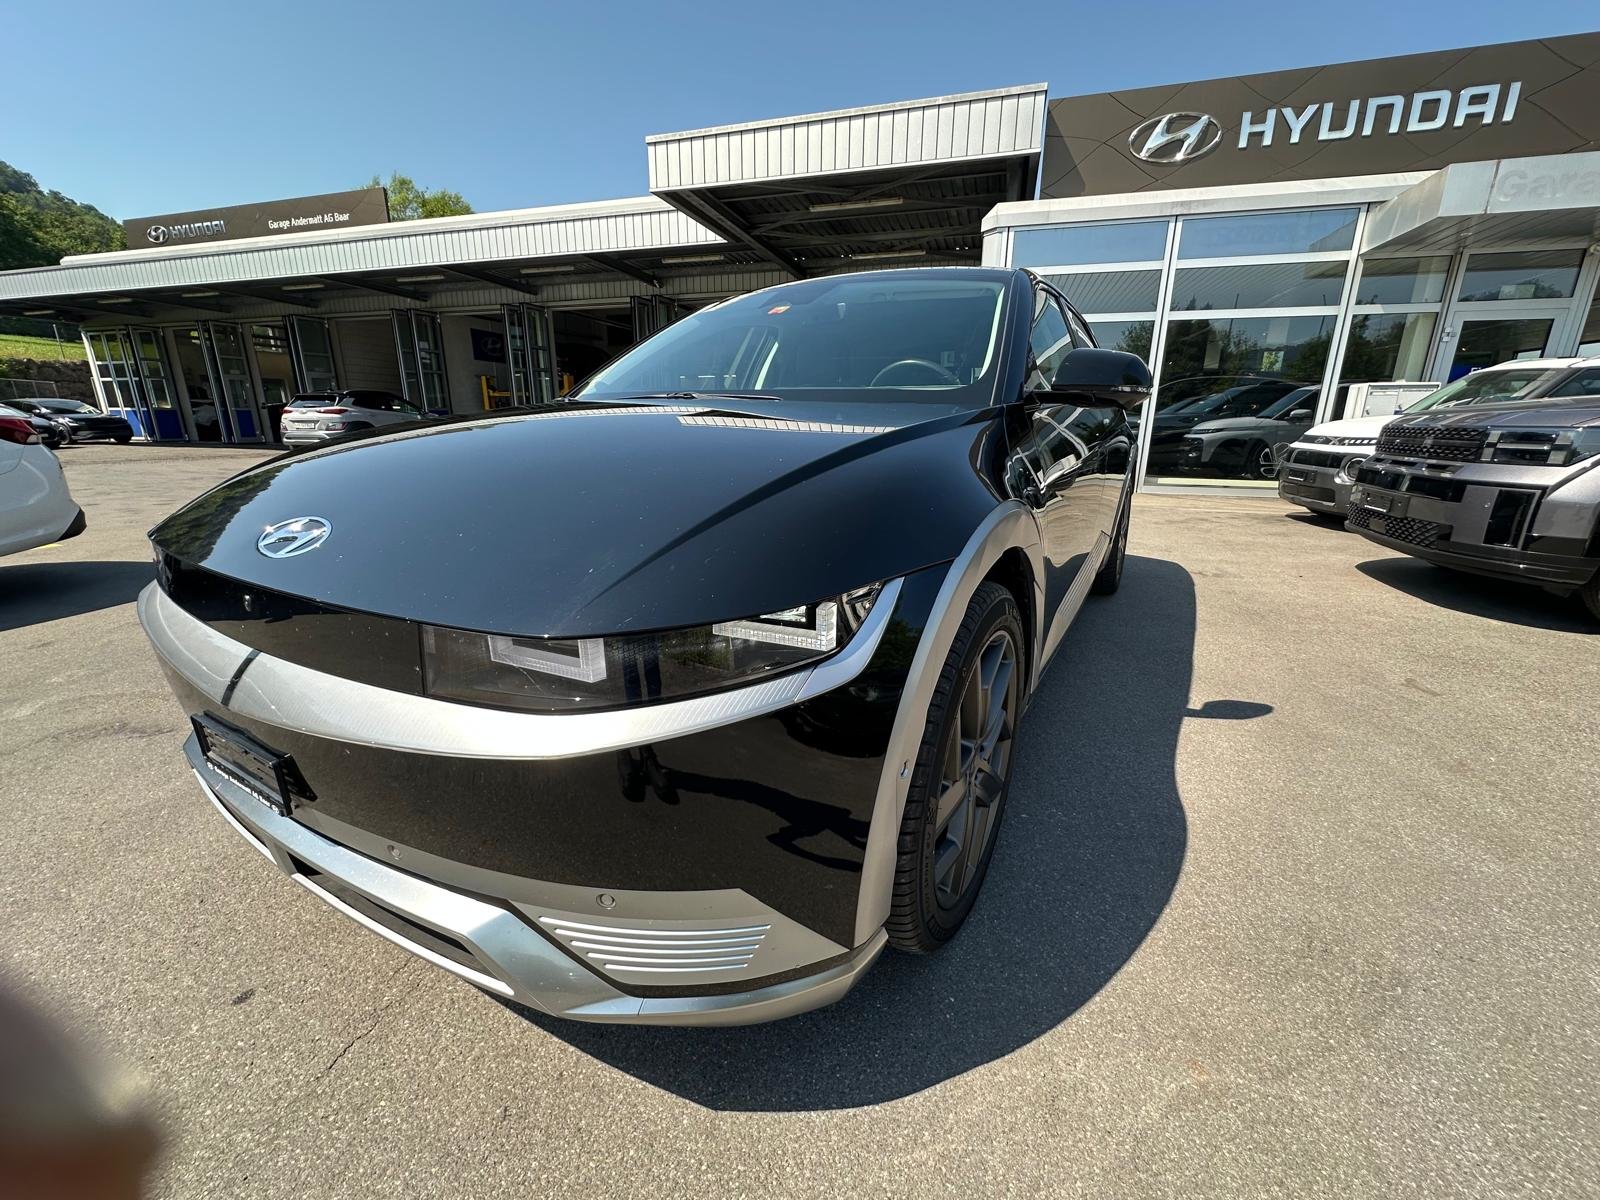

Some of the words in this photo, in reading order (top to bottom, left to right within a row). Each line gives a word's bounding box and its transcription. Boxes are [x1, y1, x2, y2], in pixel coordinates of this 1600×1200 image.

[1238, 81, 1522, 149] HYUNDAI
[169, 220, 226, 239] HYUNDAI
[268, 219, 291, 230] Garage
[291, 214, 323, 227] Andermatt
[323, 213, 334, 223] AG
[334, 212, 350, 222] Baar
